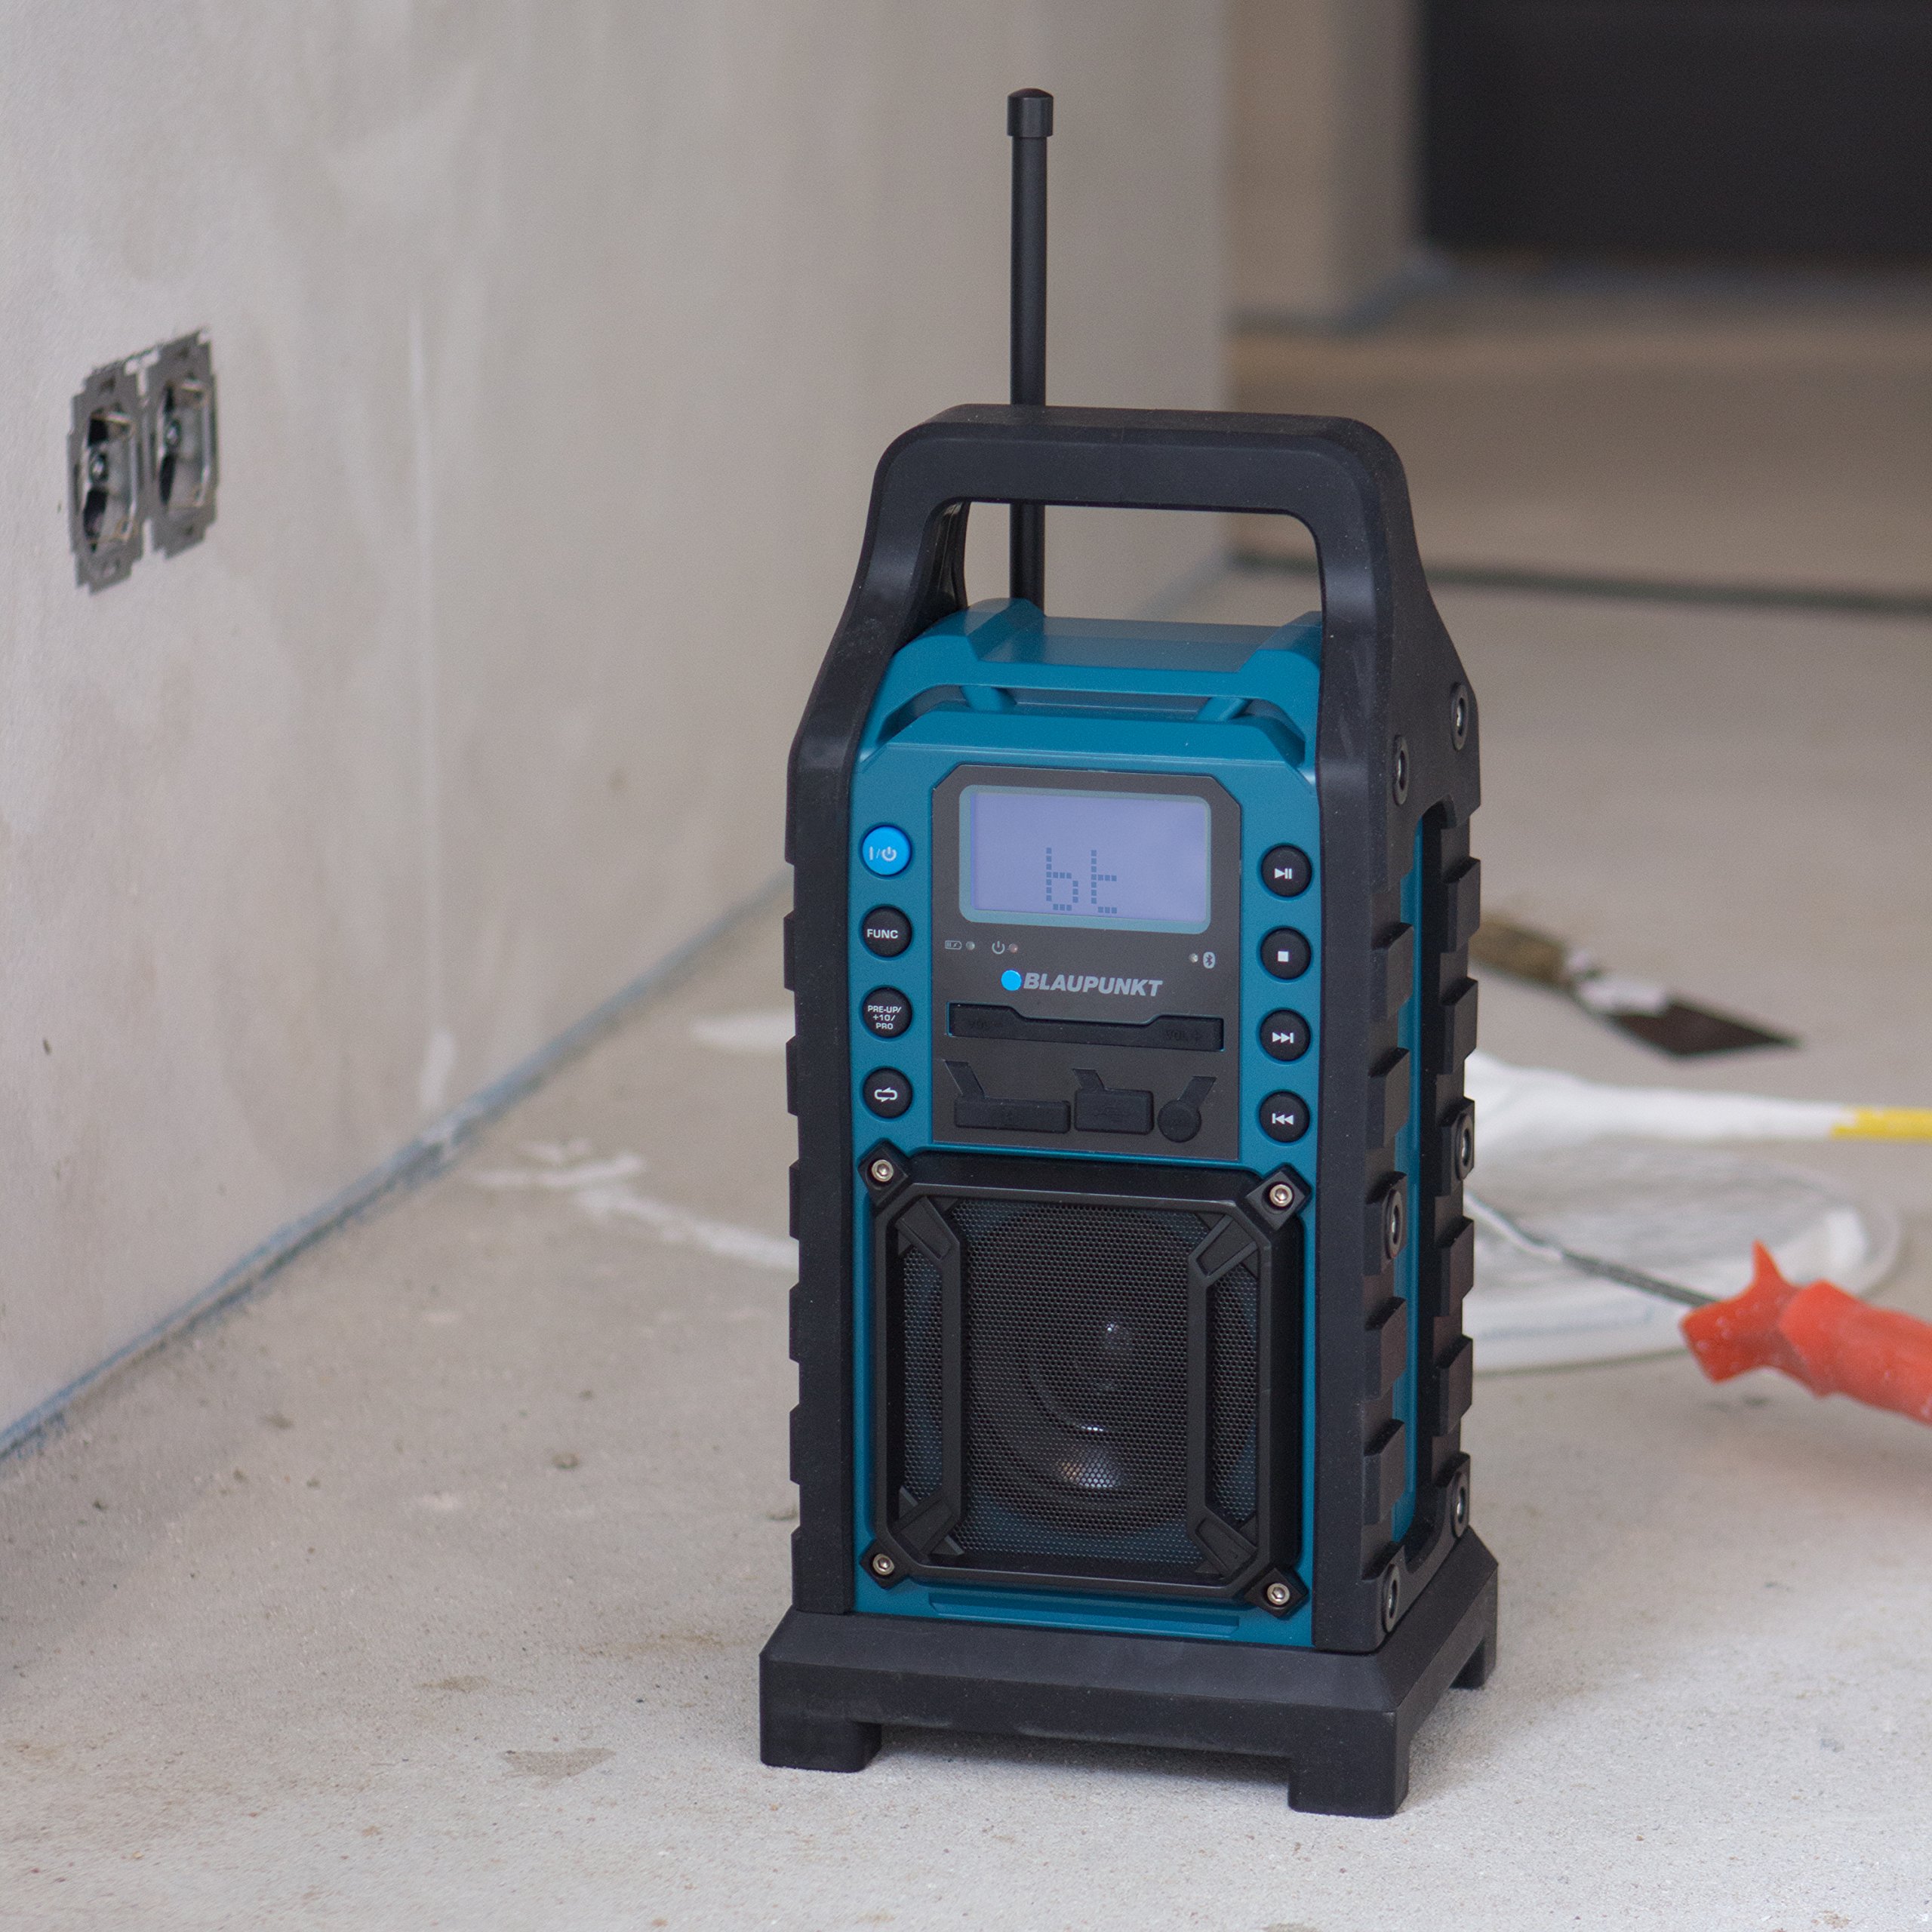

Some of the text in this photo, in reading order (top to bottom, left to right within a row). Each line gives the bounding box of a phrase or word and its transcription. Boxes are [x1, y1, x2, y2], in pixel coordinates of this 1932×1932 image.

[866, 928, 899, 939] FUNC
[1023, 972, 1163, 997] BLAUPUNKT
[867, 1004, 902, 1014] PRE-UP/
[875, 1022, 894, 1030] PRO
